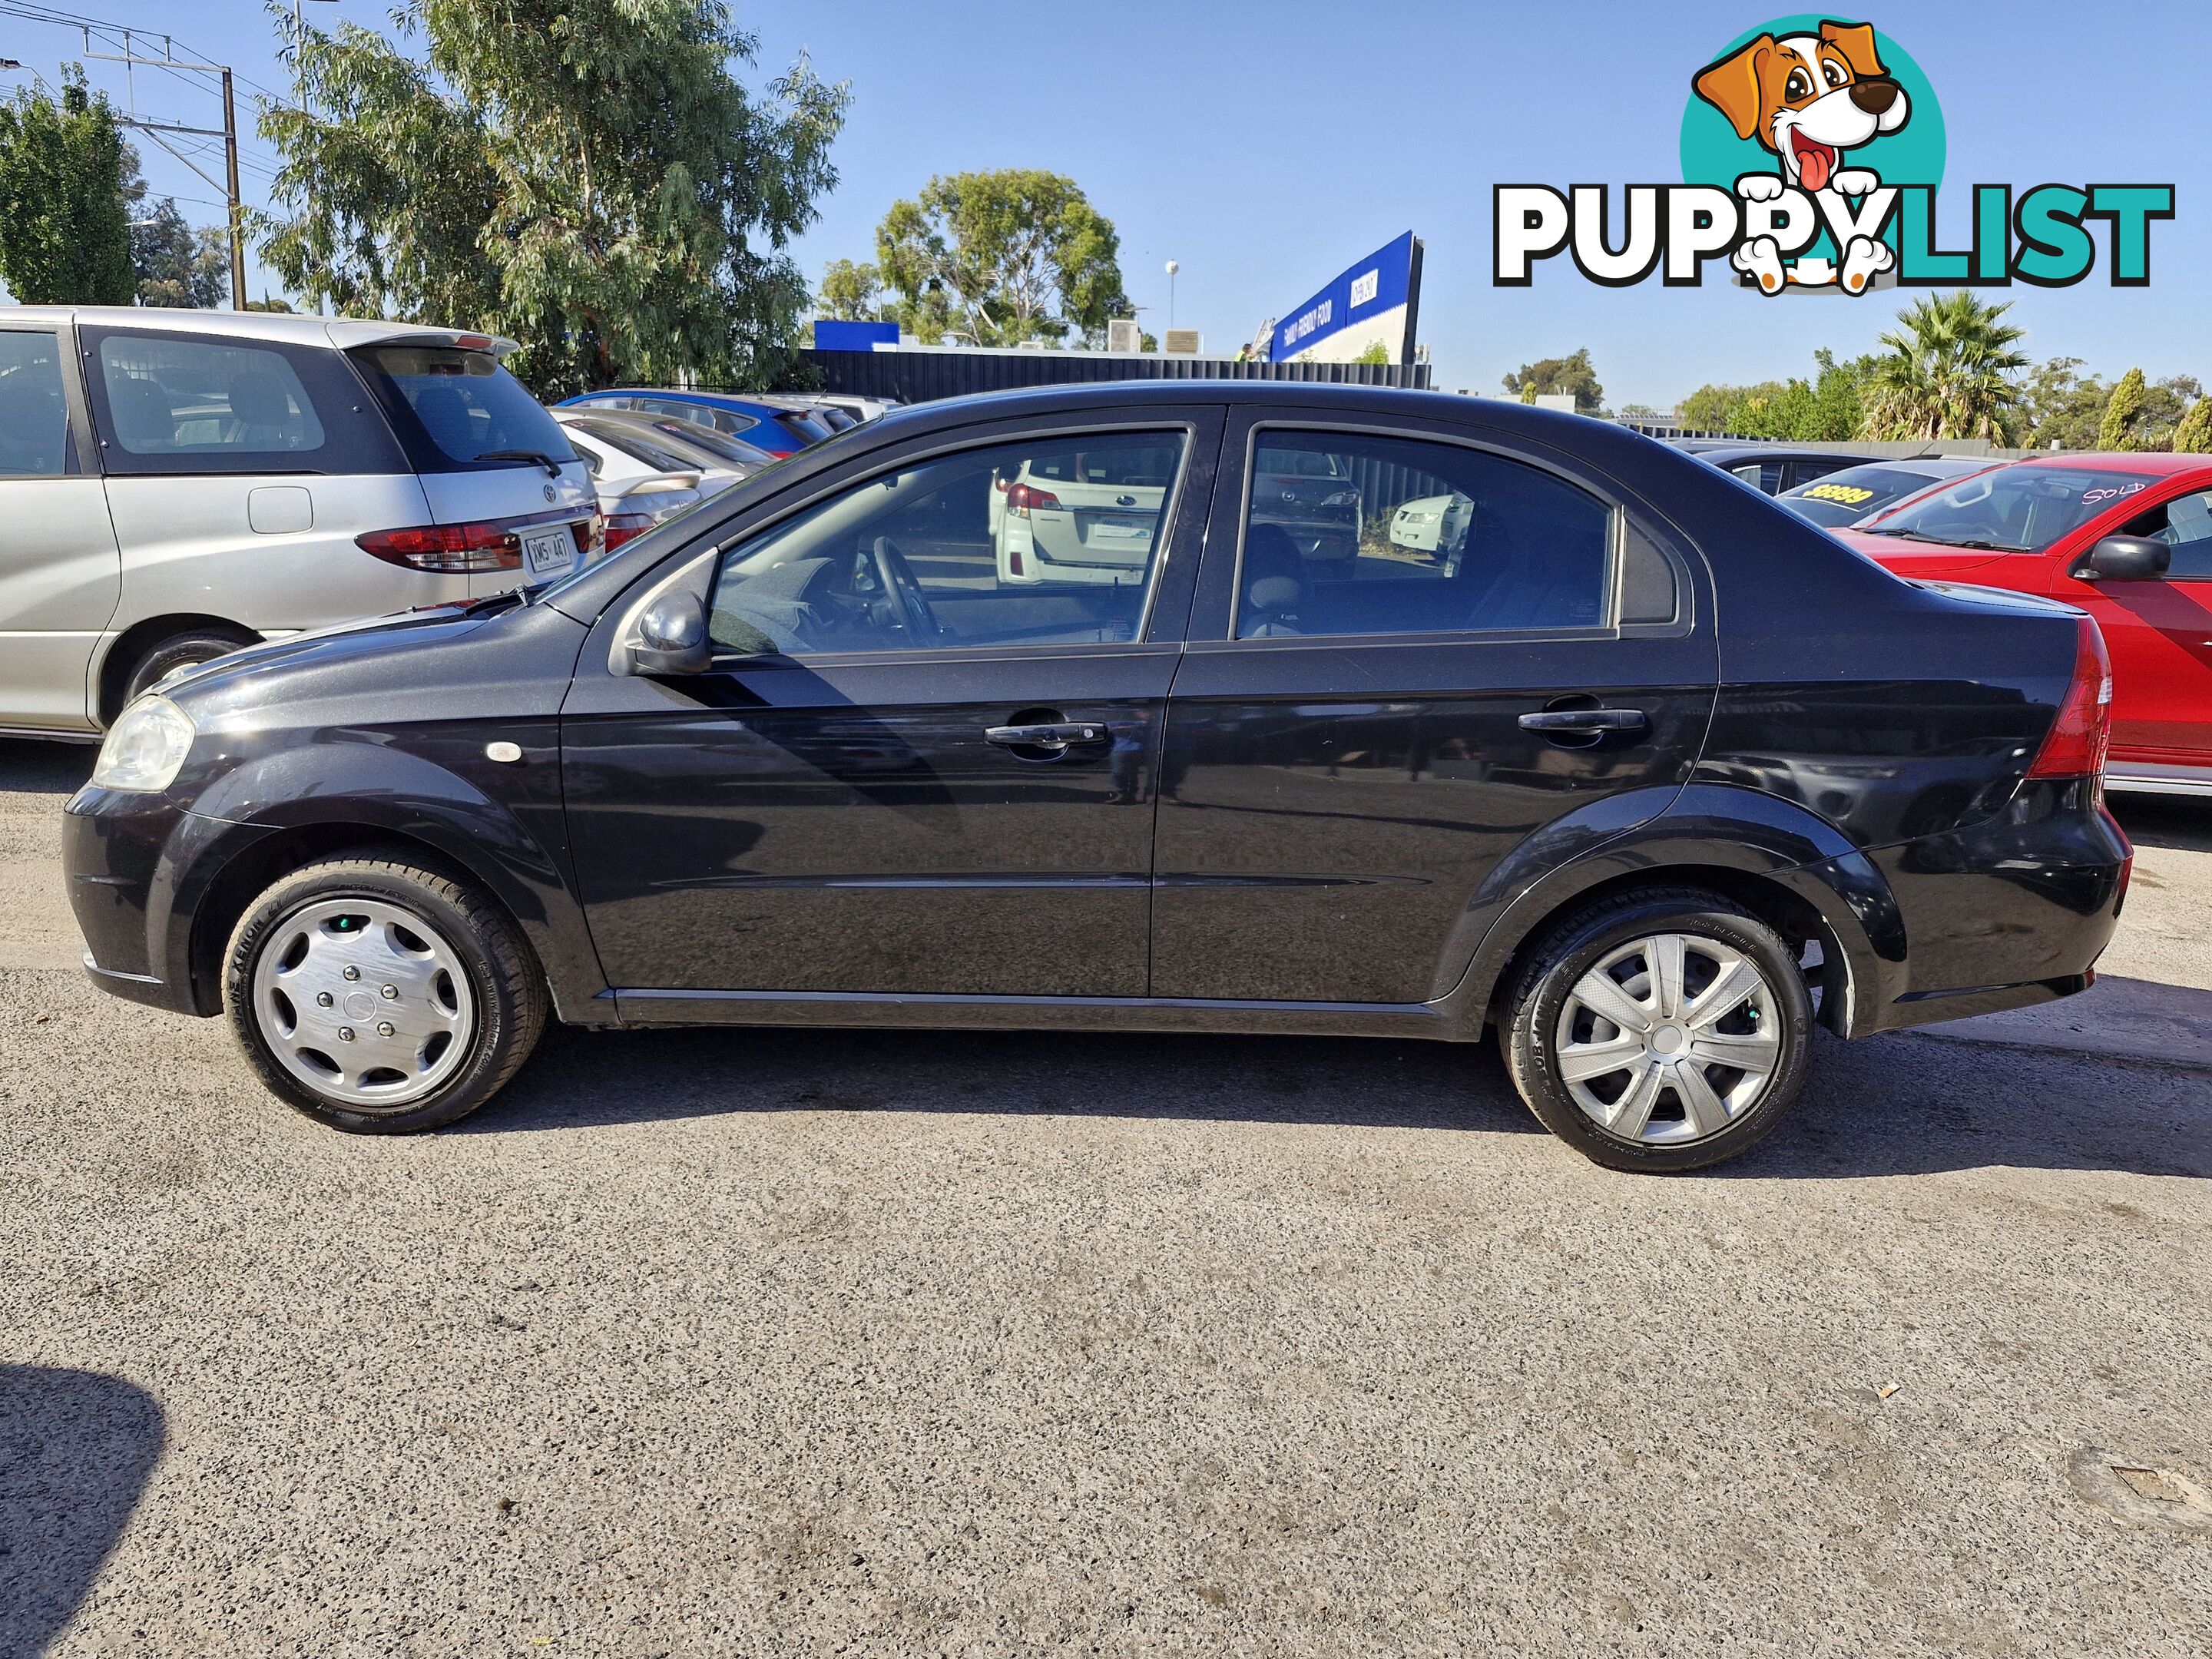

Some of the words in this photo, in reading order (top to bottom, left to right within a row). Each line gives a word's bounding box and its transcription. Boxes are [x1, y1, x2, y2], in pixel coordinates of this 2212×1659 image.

[1317, 299, 1332, 327] FOOD
[2081, 482, 2146, 505] SOLD
[531, 541, 549, 563] XMS
[553, 538, 567, 557] 447
[232, 919, 263, 973] XENON
